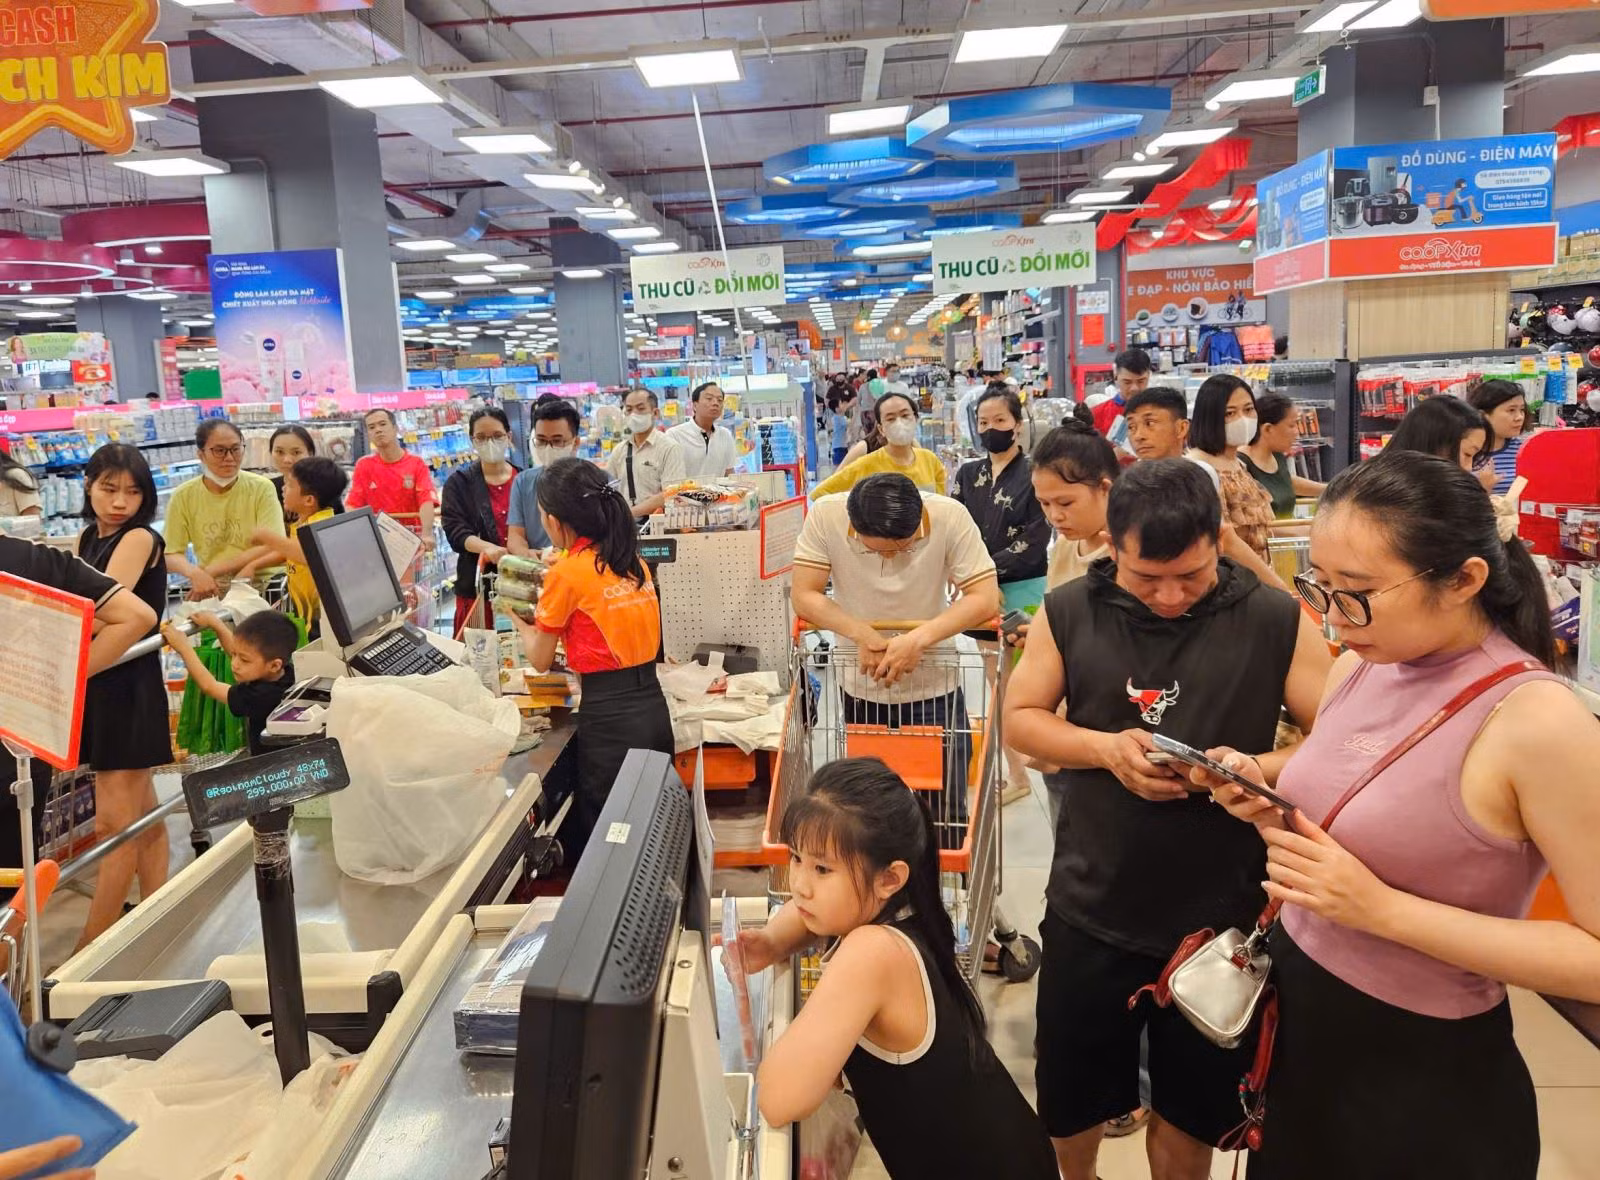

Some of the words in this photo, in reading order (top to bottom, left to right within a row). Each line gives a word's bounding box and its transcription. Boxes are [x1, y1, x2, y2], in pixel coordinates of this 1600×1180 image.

[0, 6, 78, 47] CASH
[71, 52, 166, 98] KIM
[1426, 149, 1466, 165] DÙNG
[1480, 146, 1515, 163] ĐIỆN
[1519, 144, 1553, 159] MÁY
[938, 260, 972, 279] THU
[976, 256, 999, 275] CŨ
[1020, 248, 1050, 273] ĐỔI
[1055, 248, 1090, 270] MỚI
[1166, 269, 1188, 281] KHU
[1192, 268, 1216, 279] VỰC
[638, 282, 670, 299] THU
[673, 277, 695, 296] CŨ
[747, 271, 779, 292] MỚI
[1137, 285, 1163, 299] ĐẠP
[1172, 280, 1202, 293] NÓN
[1204, 279, 1230, 292] BẢO
[296, 758, 326, 774] 48x74
[246, 775, 307, 800] 299.000,00
[310, 768, 329, 782] VND
